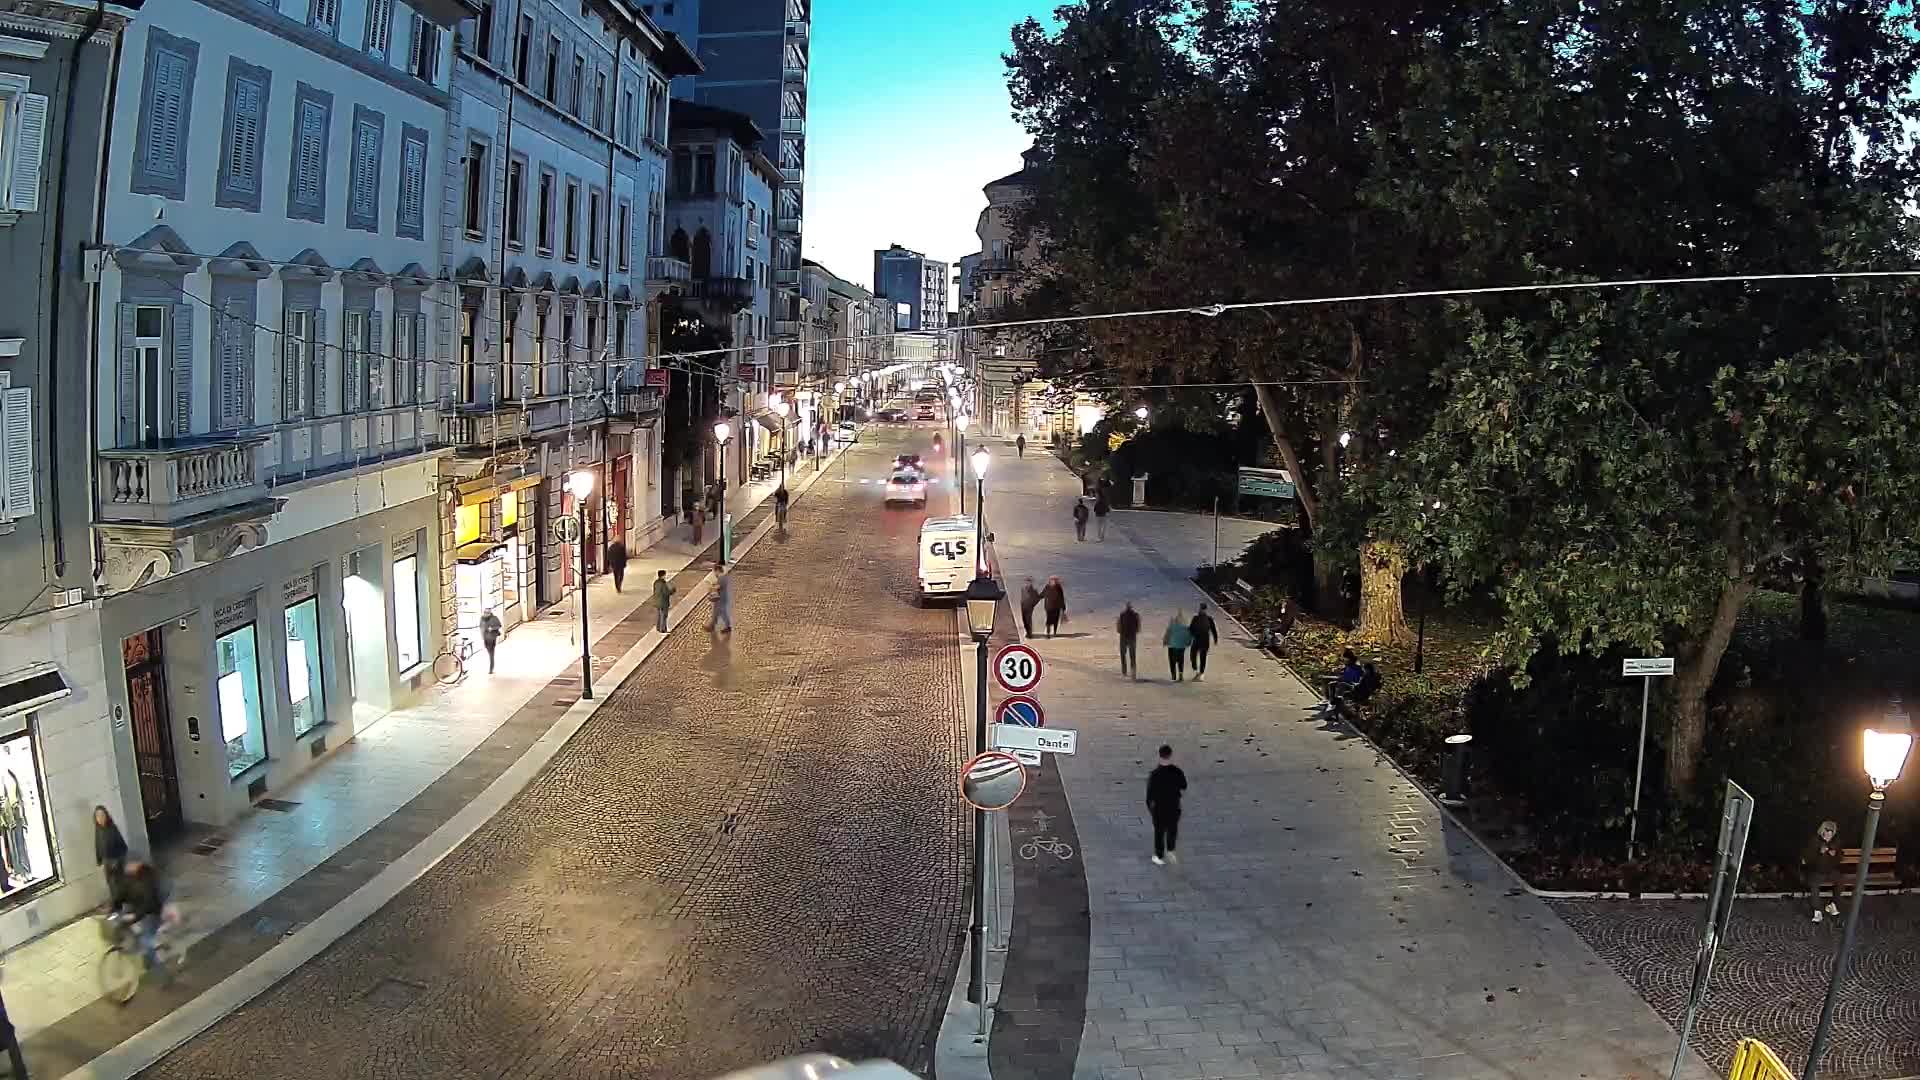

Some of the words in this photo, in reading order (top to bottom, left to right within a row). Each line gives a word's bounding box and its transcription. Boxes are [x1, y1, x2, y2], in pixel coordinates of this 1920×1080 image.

[930, 541, 967, 557] GLS
[1005, 657, 1033, 680] 30
[1038, 737, 1069, 748] Dante
